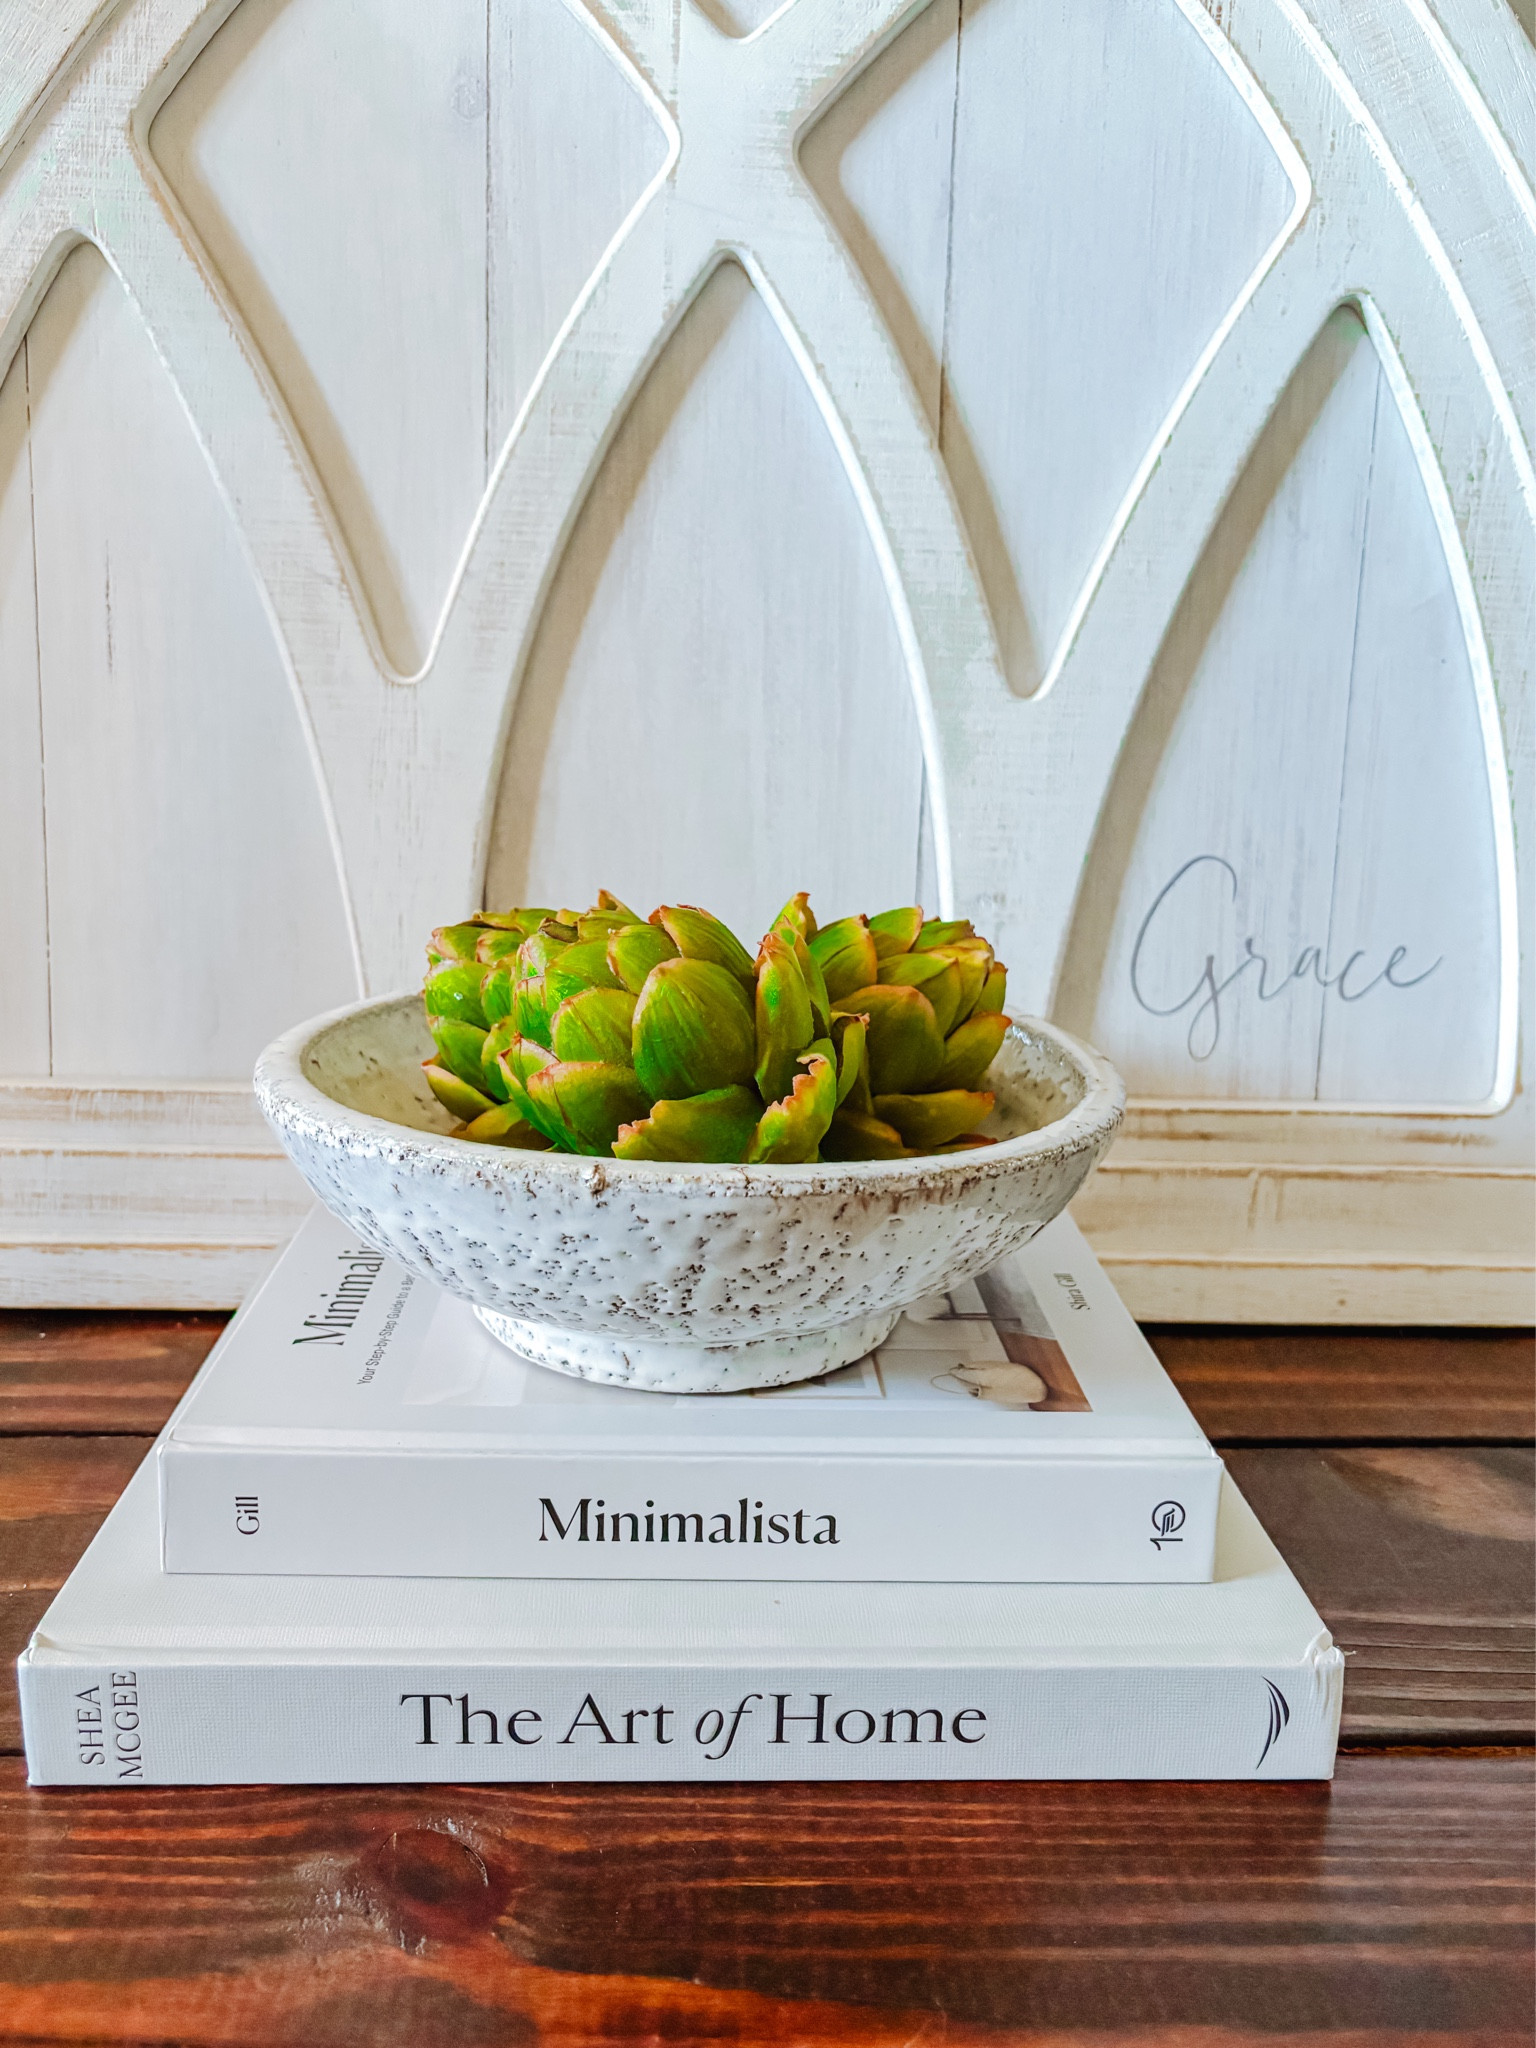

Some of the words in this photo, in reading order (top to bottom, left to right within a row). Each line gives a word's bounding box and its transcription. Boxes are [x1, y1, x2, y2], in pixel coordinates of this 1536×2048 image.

[1130, 855, 1444, 1062] Grace
[386, 1300, 406, 1319] Guide
[396, 1291, 409, 1299] to
[365, 1320, 399, 1366] Step-by-Step
[357, 1367, 376, 1384] Your
[235, 1496, 260, 1535] Gill
[538, 1497, 841, 1544] Minimalista
[75, 1685, 105, 1765] SHEA
[112, 1671, 143, 1778] MCGEE
[400, 1693, 543, 1745] The
[557, 1693, 674, 1745] Art
[694, 1693, 764, 1760] of
[768, 1693, 988, 1744] Home
